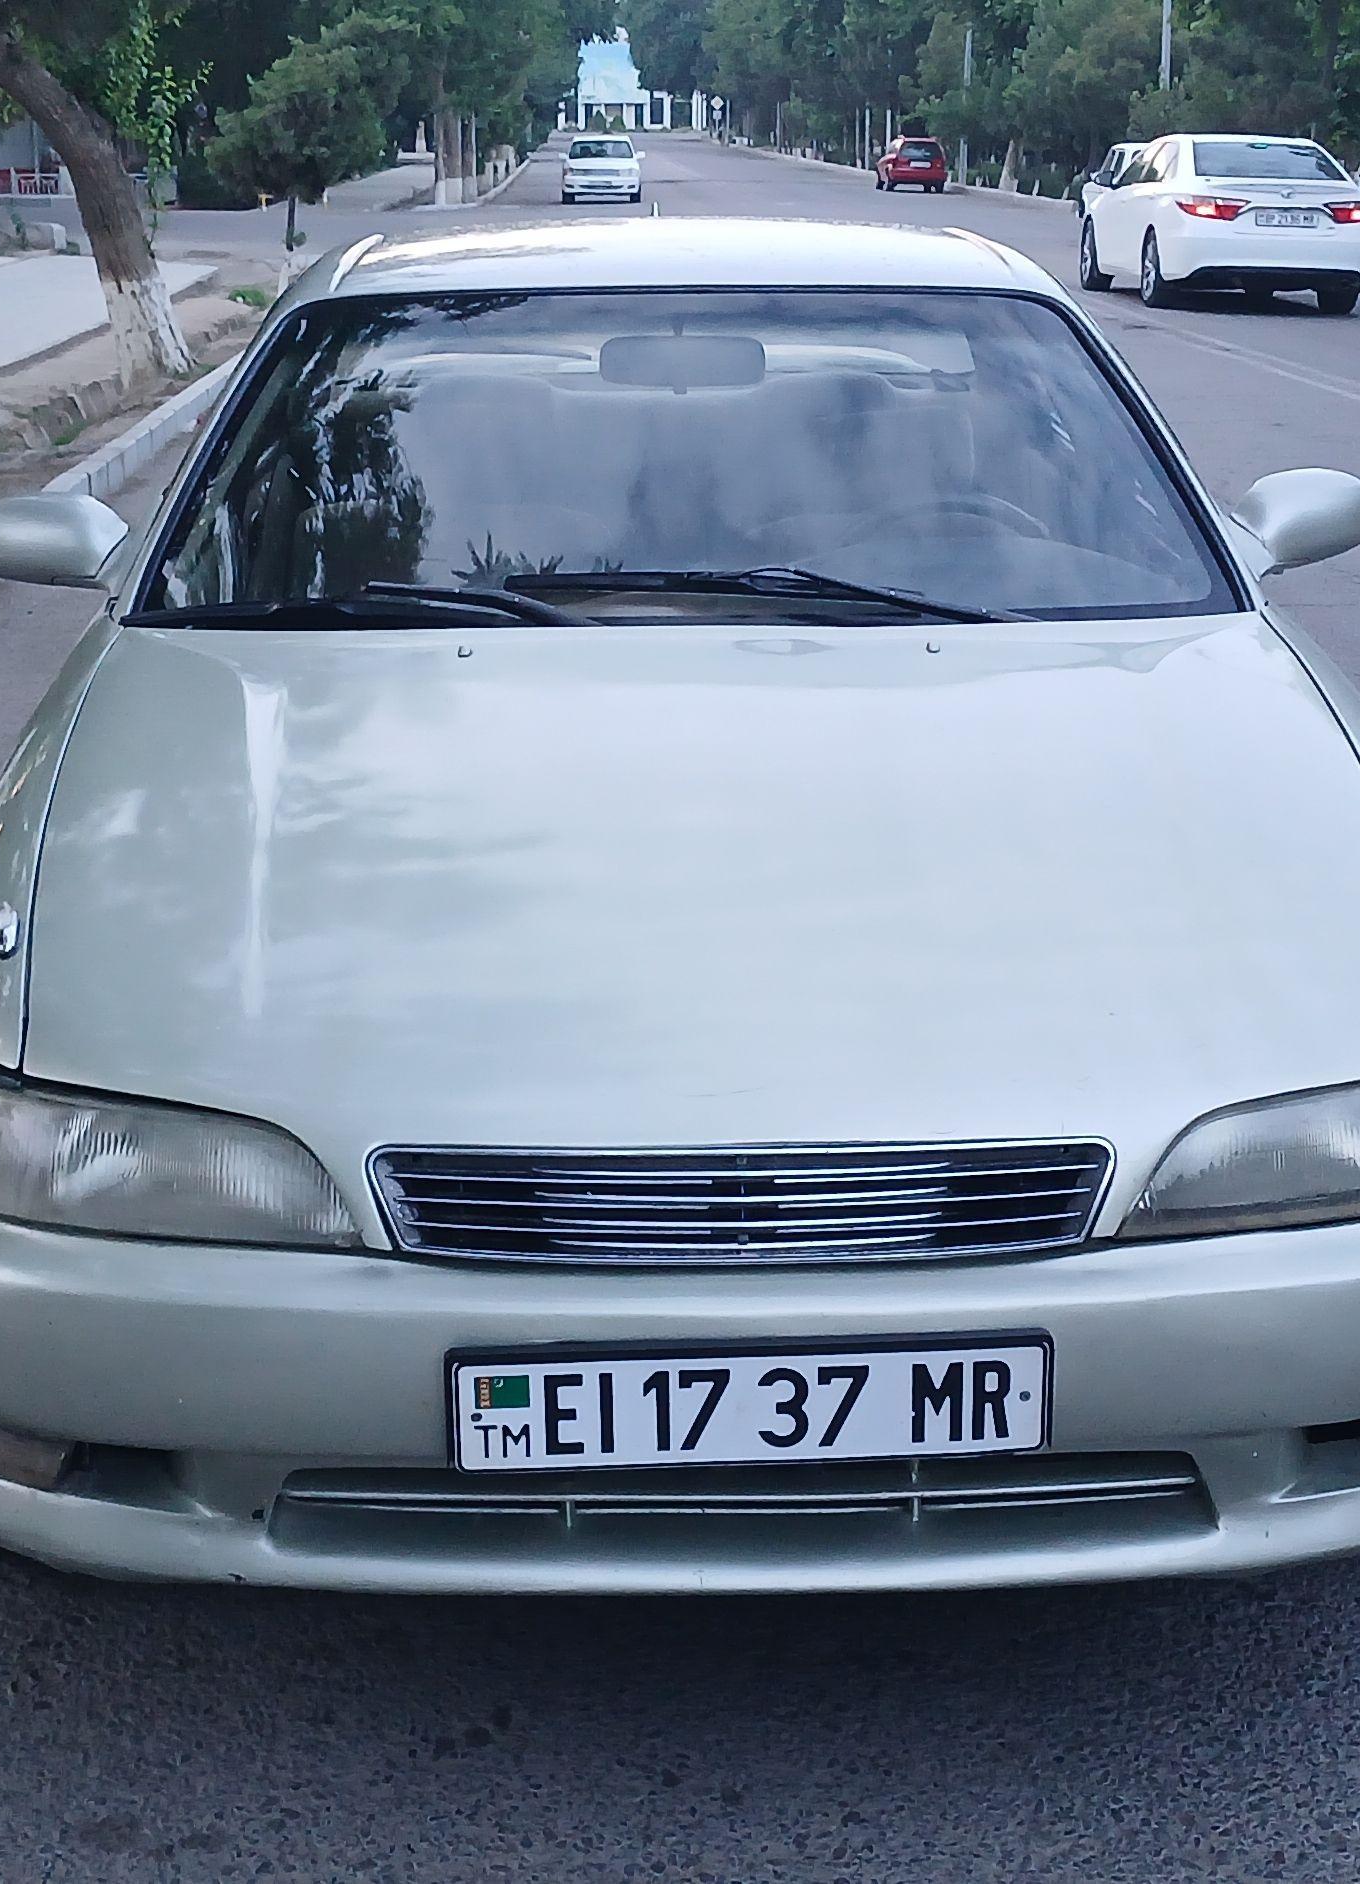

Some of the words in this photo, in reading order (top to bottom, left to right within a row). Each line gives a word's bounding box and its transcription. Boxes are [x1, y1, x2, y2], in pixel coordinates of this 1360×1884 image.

[642, 1368, 731, 1451] 17
[757, 1364, 870, 1448] 37
[910, 1360, 1011, 1444] MR
[473, 1424, 531, 1459] TM
